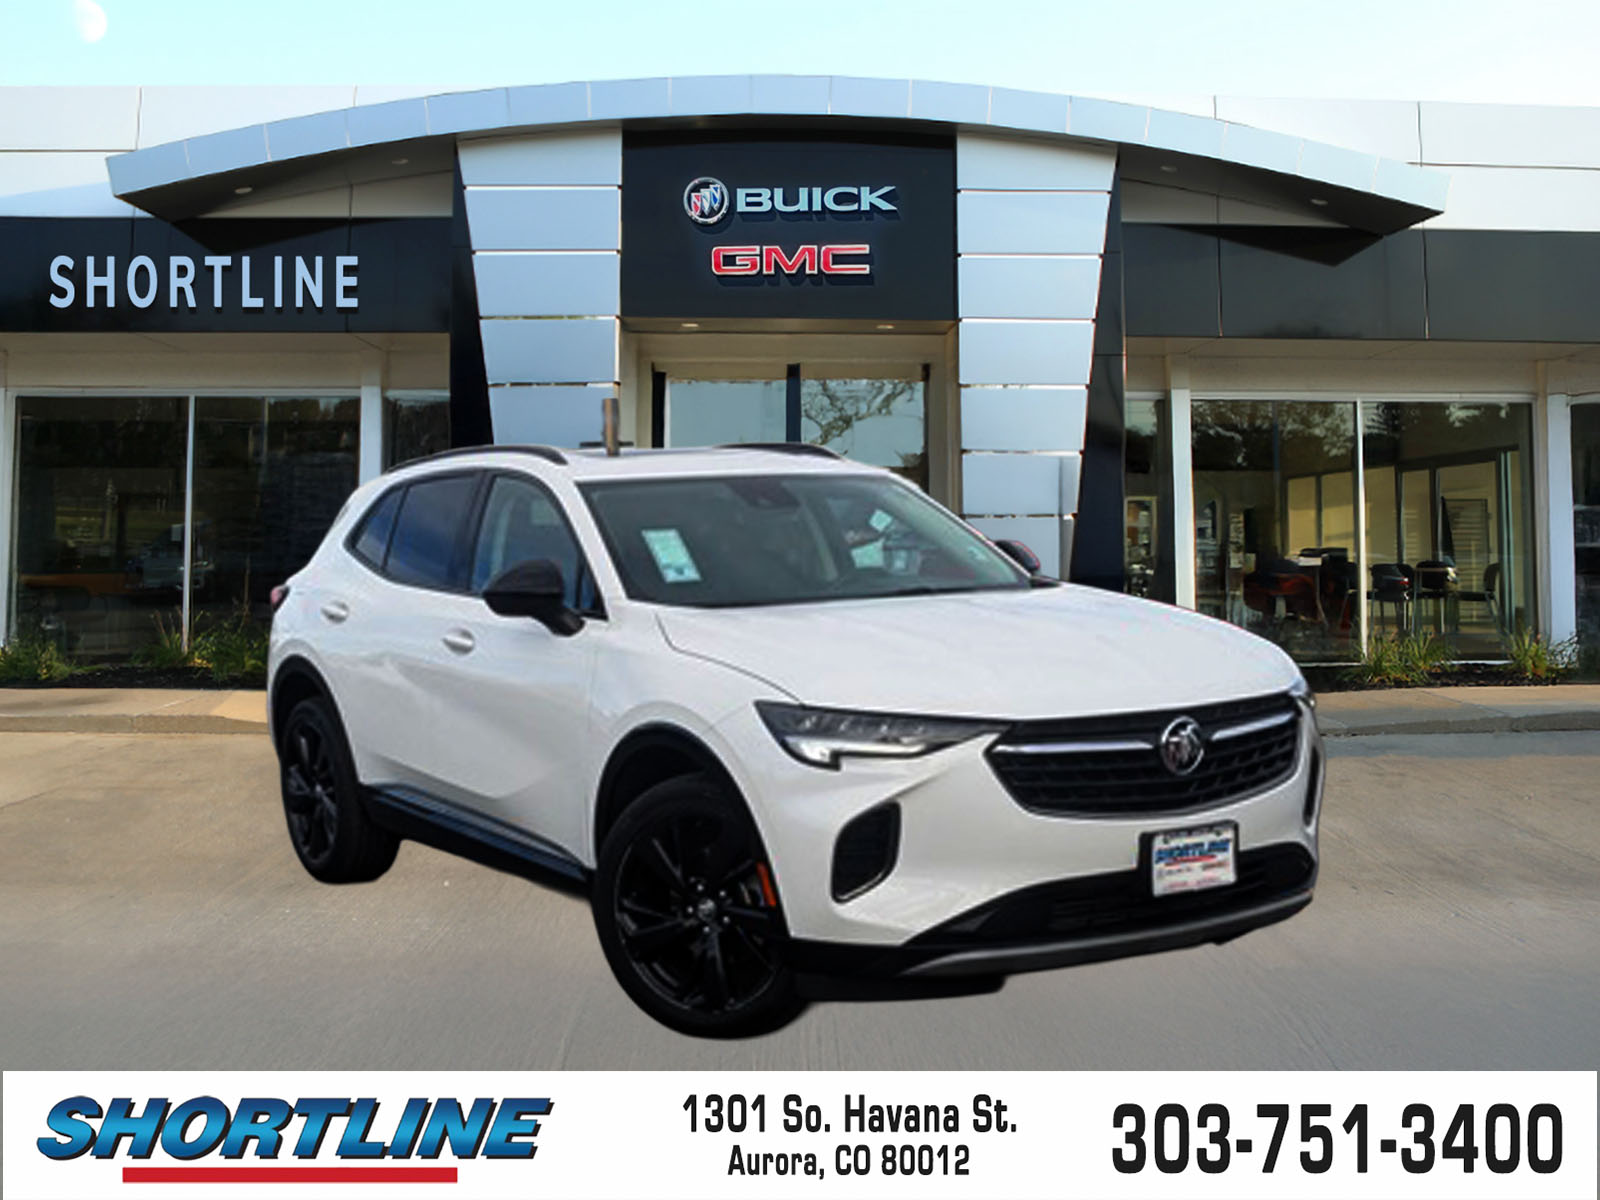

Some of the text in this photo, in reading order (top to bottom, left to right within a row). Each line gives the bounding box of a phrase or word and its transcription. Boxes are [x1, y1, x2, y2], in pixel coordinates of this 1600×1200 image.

[736, 185, 898, 213] BUICK
[711, 244, 870, 275] GMC
[49, 255, 360, 309] SHORTLINE
